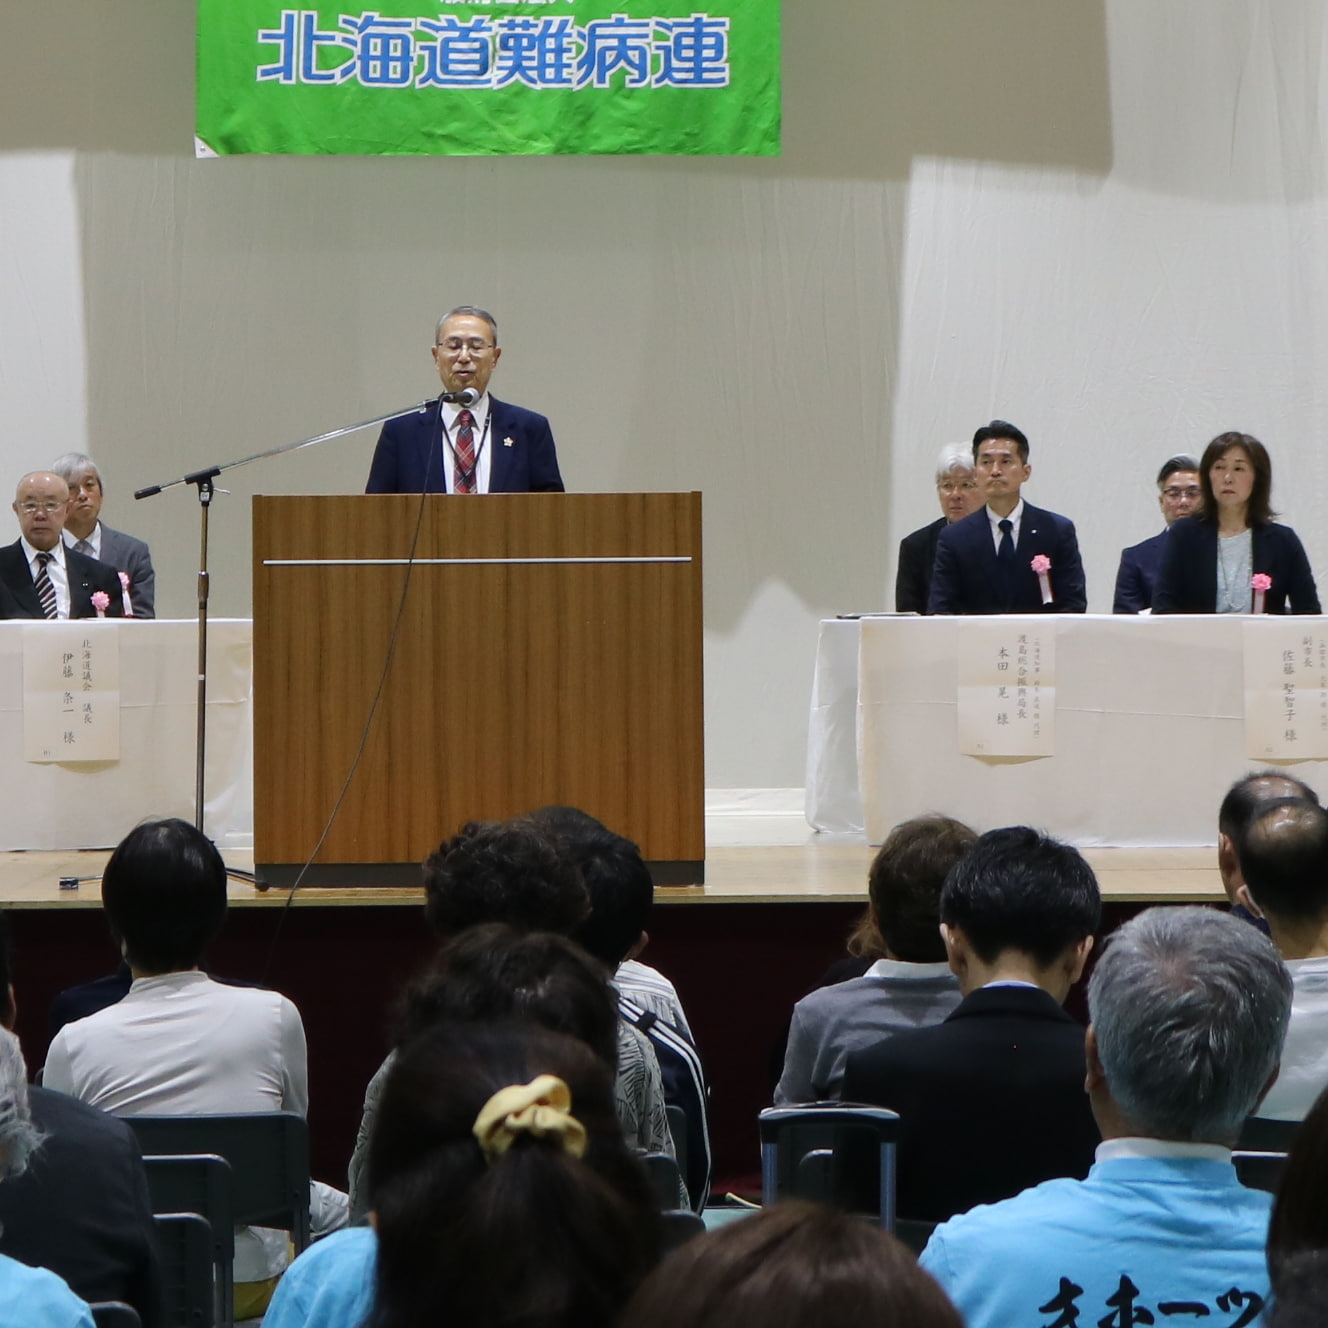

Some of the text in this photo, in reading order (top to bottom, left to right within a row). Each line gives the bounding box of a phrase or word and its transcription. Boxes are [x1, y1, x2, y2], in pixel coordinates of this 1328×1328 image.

[256, 9, 731, 91] 北海道難病連
